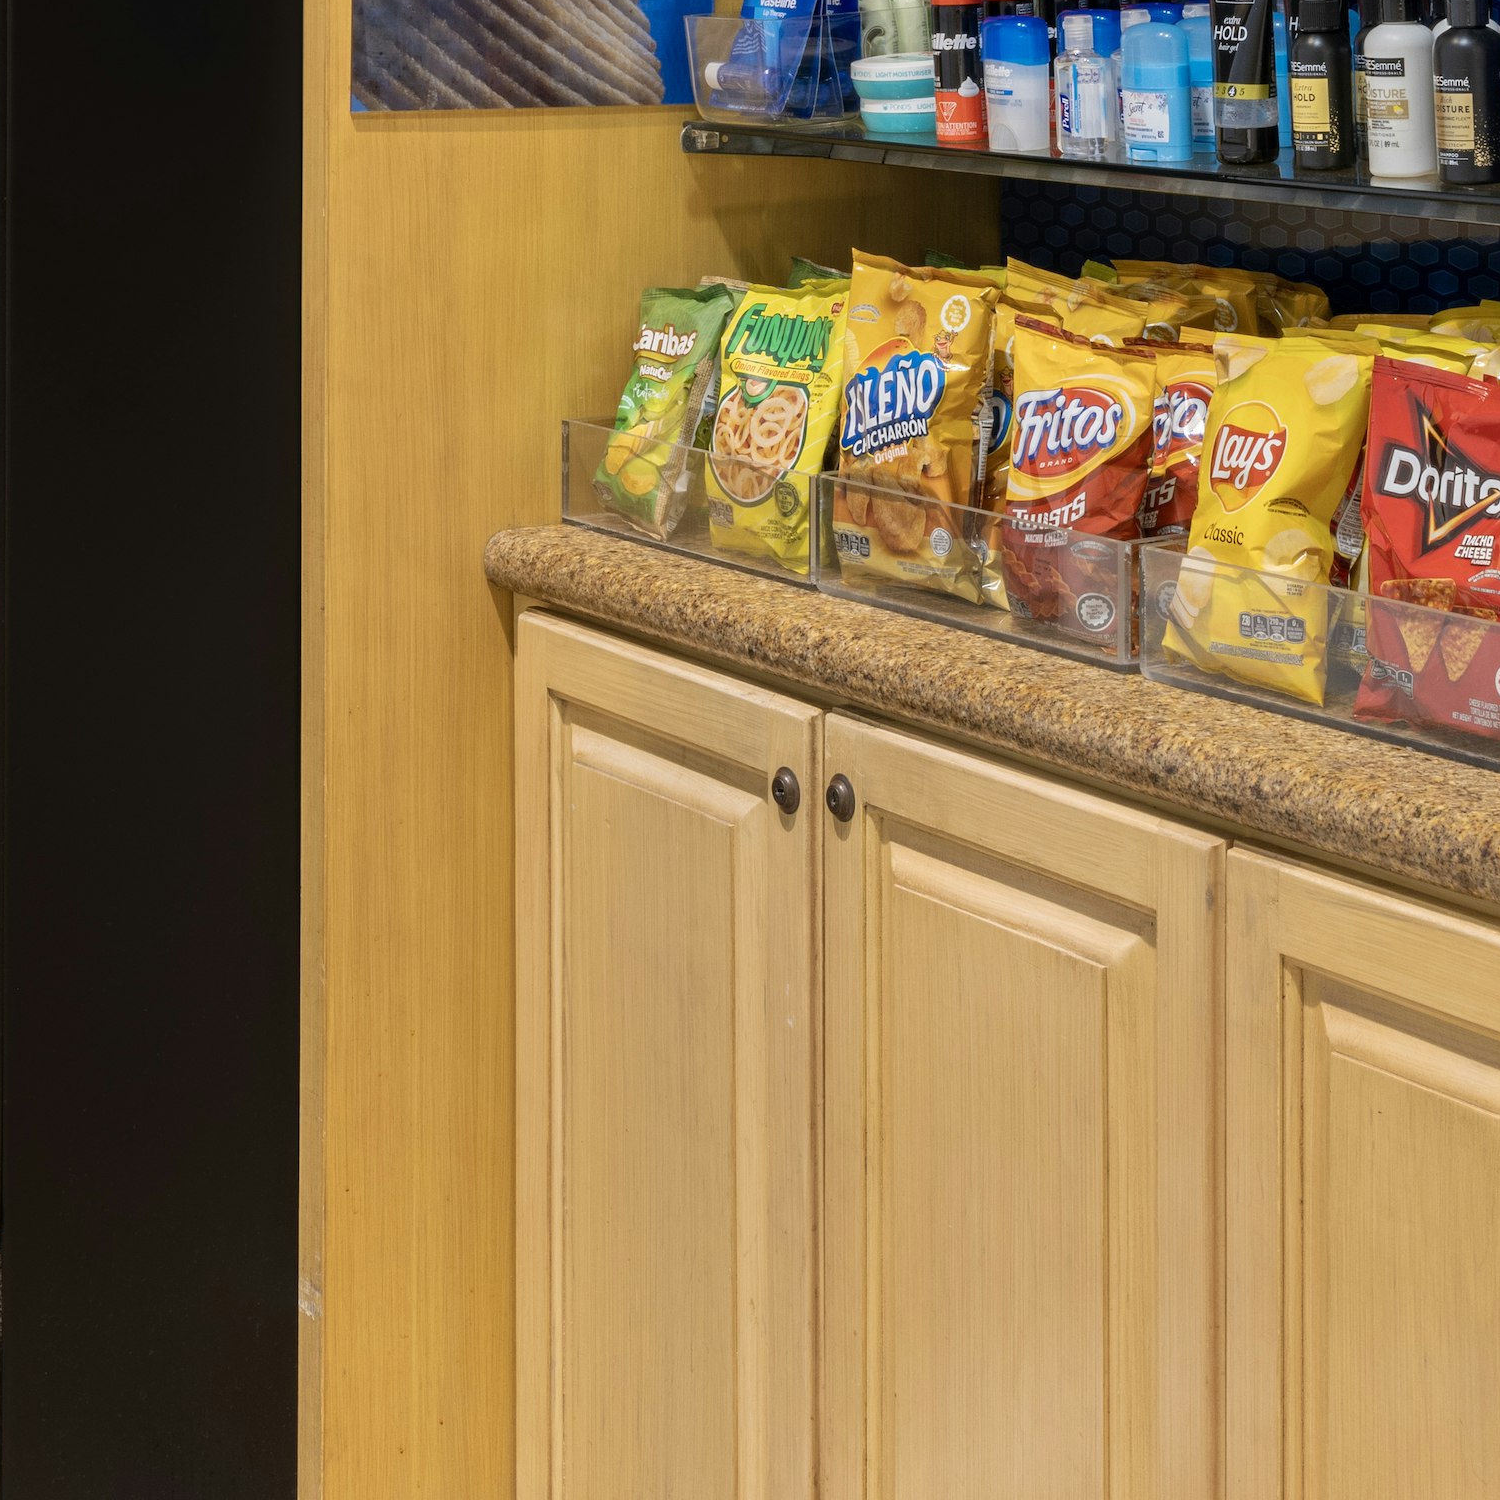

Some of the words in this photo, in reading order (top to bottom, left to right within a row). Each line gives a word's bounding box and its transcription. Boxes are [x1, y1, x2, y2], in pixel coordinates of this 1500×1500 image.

[1224, 16, 1241, 24] extra
[932, 33, 977, 50] illette
[1214, 25, 1248, 42] HOLD
[1218, 42, 1229, 50] hair
[1229, 43, 1240, 53] gel
[893, 69, 932, 77] MOISTURISER
[1062, 98, 1070, 129] Purell
[1128, 102, 1146, 117] Secret
[734, 360, 755, 373] Onion
[756, 365, 789, 379] Flavored
[791, 370, 810, 382] Rings
[847, 356, 938, 441] ISLEÑO
[1012, 388, 1123, 465] Fritos
[852, 418, 928, 457] CHICHARRÓN
[874, 443, 908, 465] Original
[1039, 456, 1074, 469] BRAND
[1211, 424, 1282, 490] Lay's
[1203, 521, 1245, 546] Classic
[1461, 534, 1495, 548] NACHO
[1454, 546, 1493, 560] CHEESE
